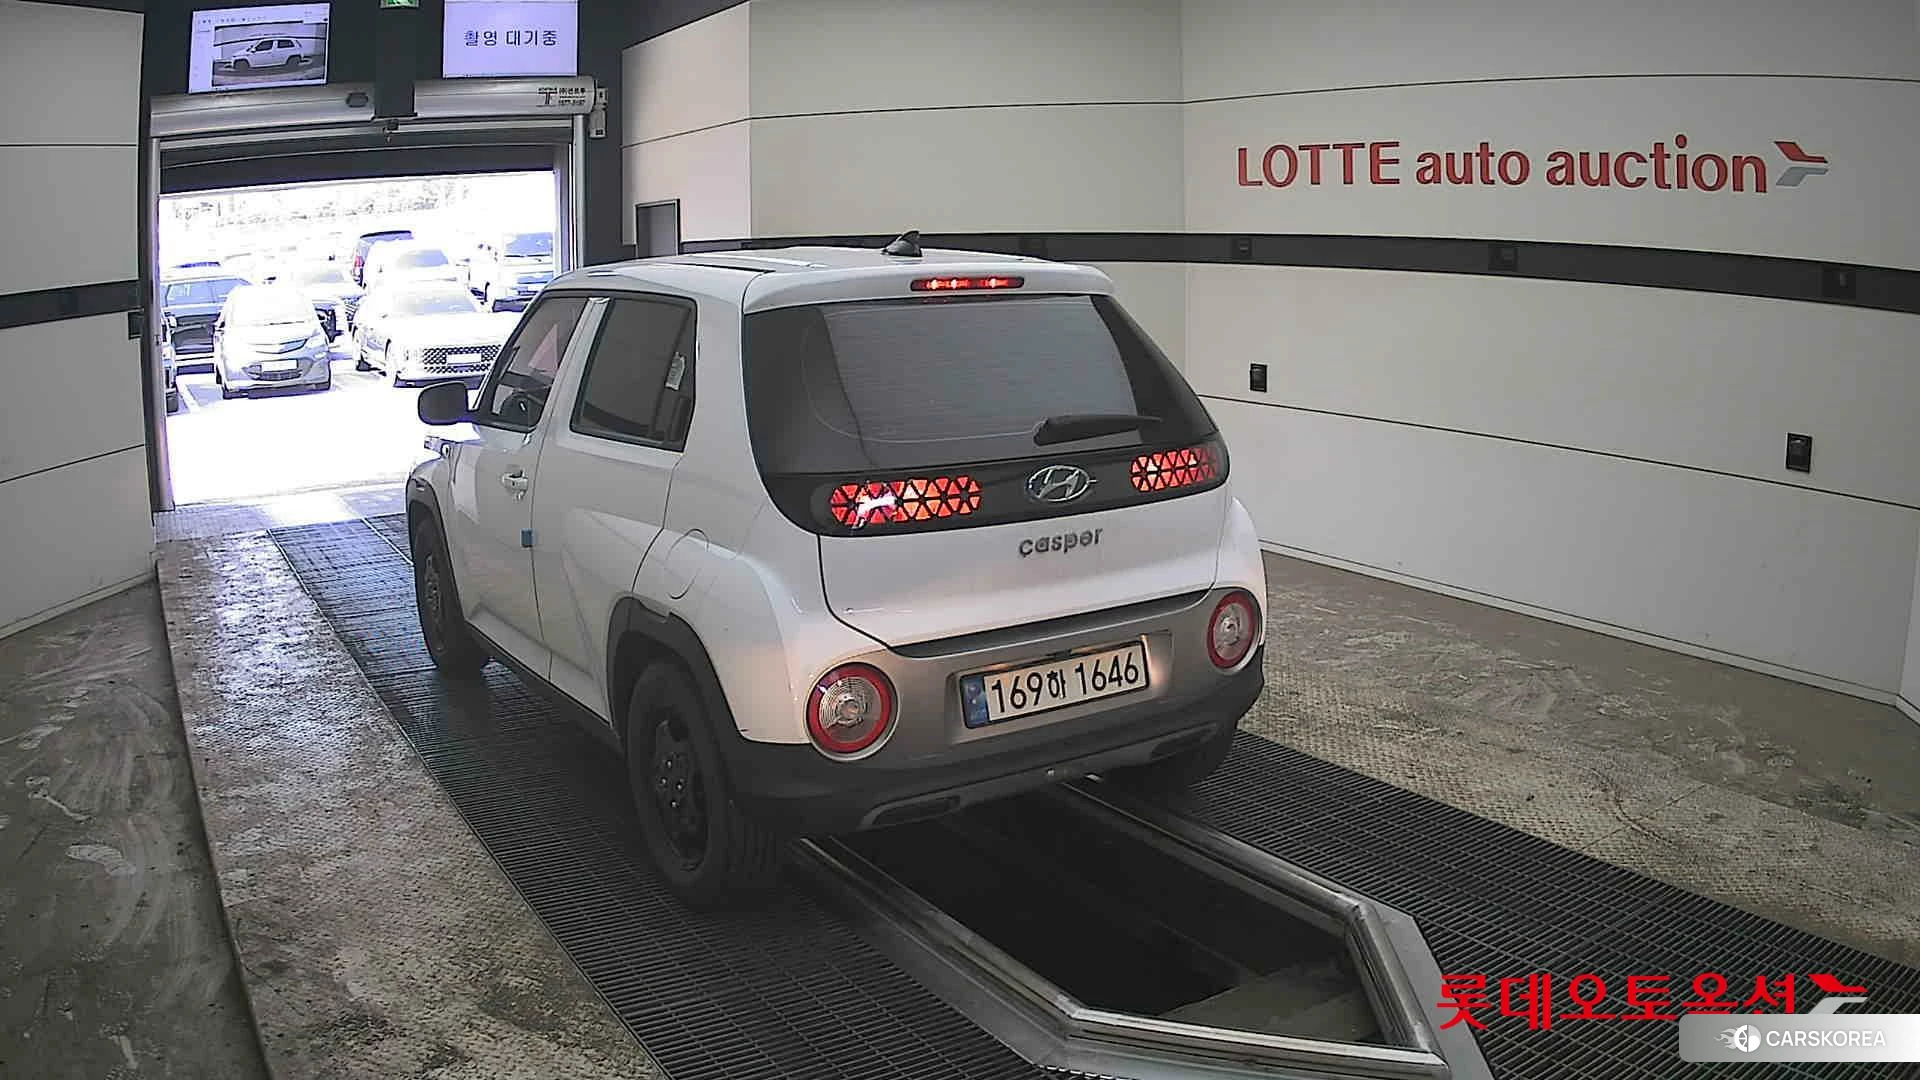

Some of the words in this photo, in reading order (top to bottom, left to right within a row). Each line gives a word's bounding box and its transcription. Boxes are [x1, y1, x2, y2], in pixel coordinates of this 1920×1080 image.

[506, 29, 557, 46] 대기중
[1238, 141, 1400, 188] LOTTE
[1415, 142, 1530, 186] auto
[1545, 134, 1767, 193] auction
[1018, 527, 1103, 558] casper
[991, 669, 1066, 713] 169하
[1074, 651, 1139, 696] 1646
